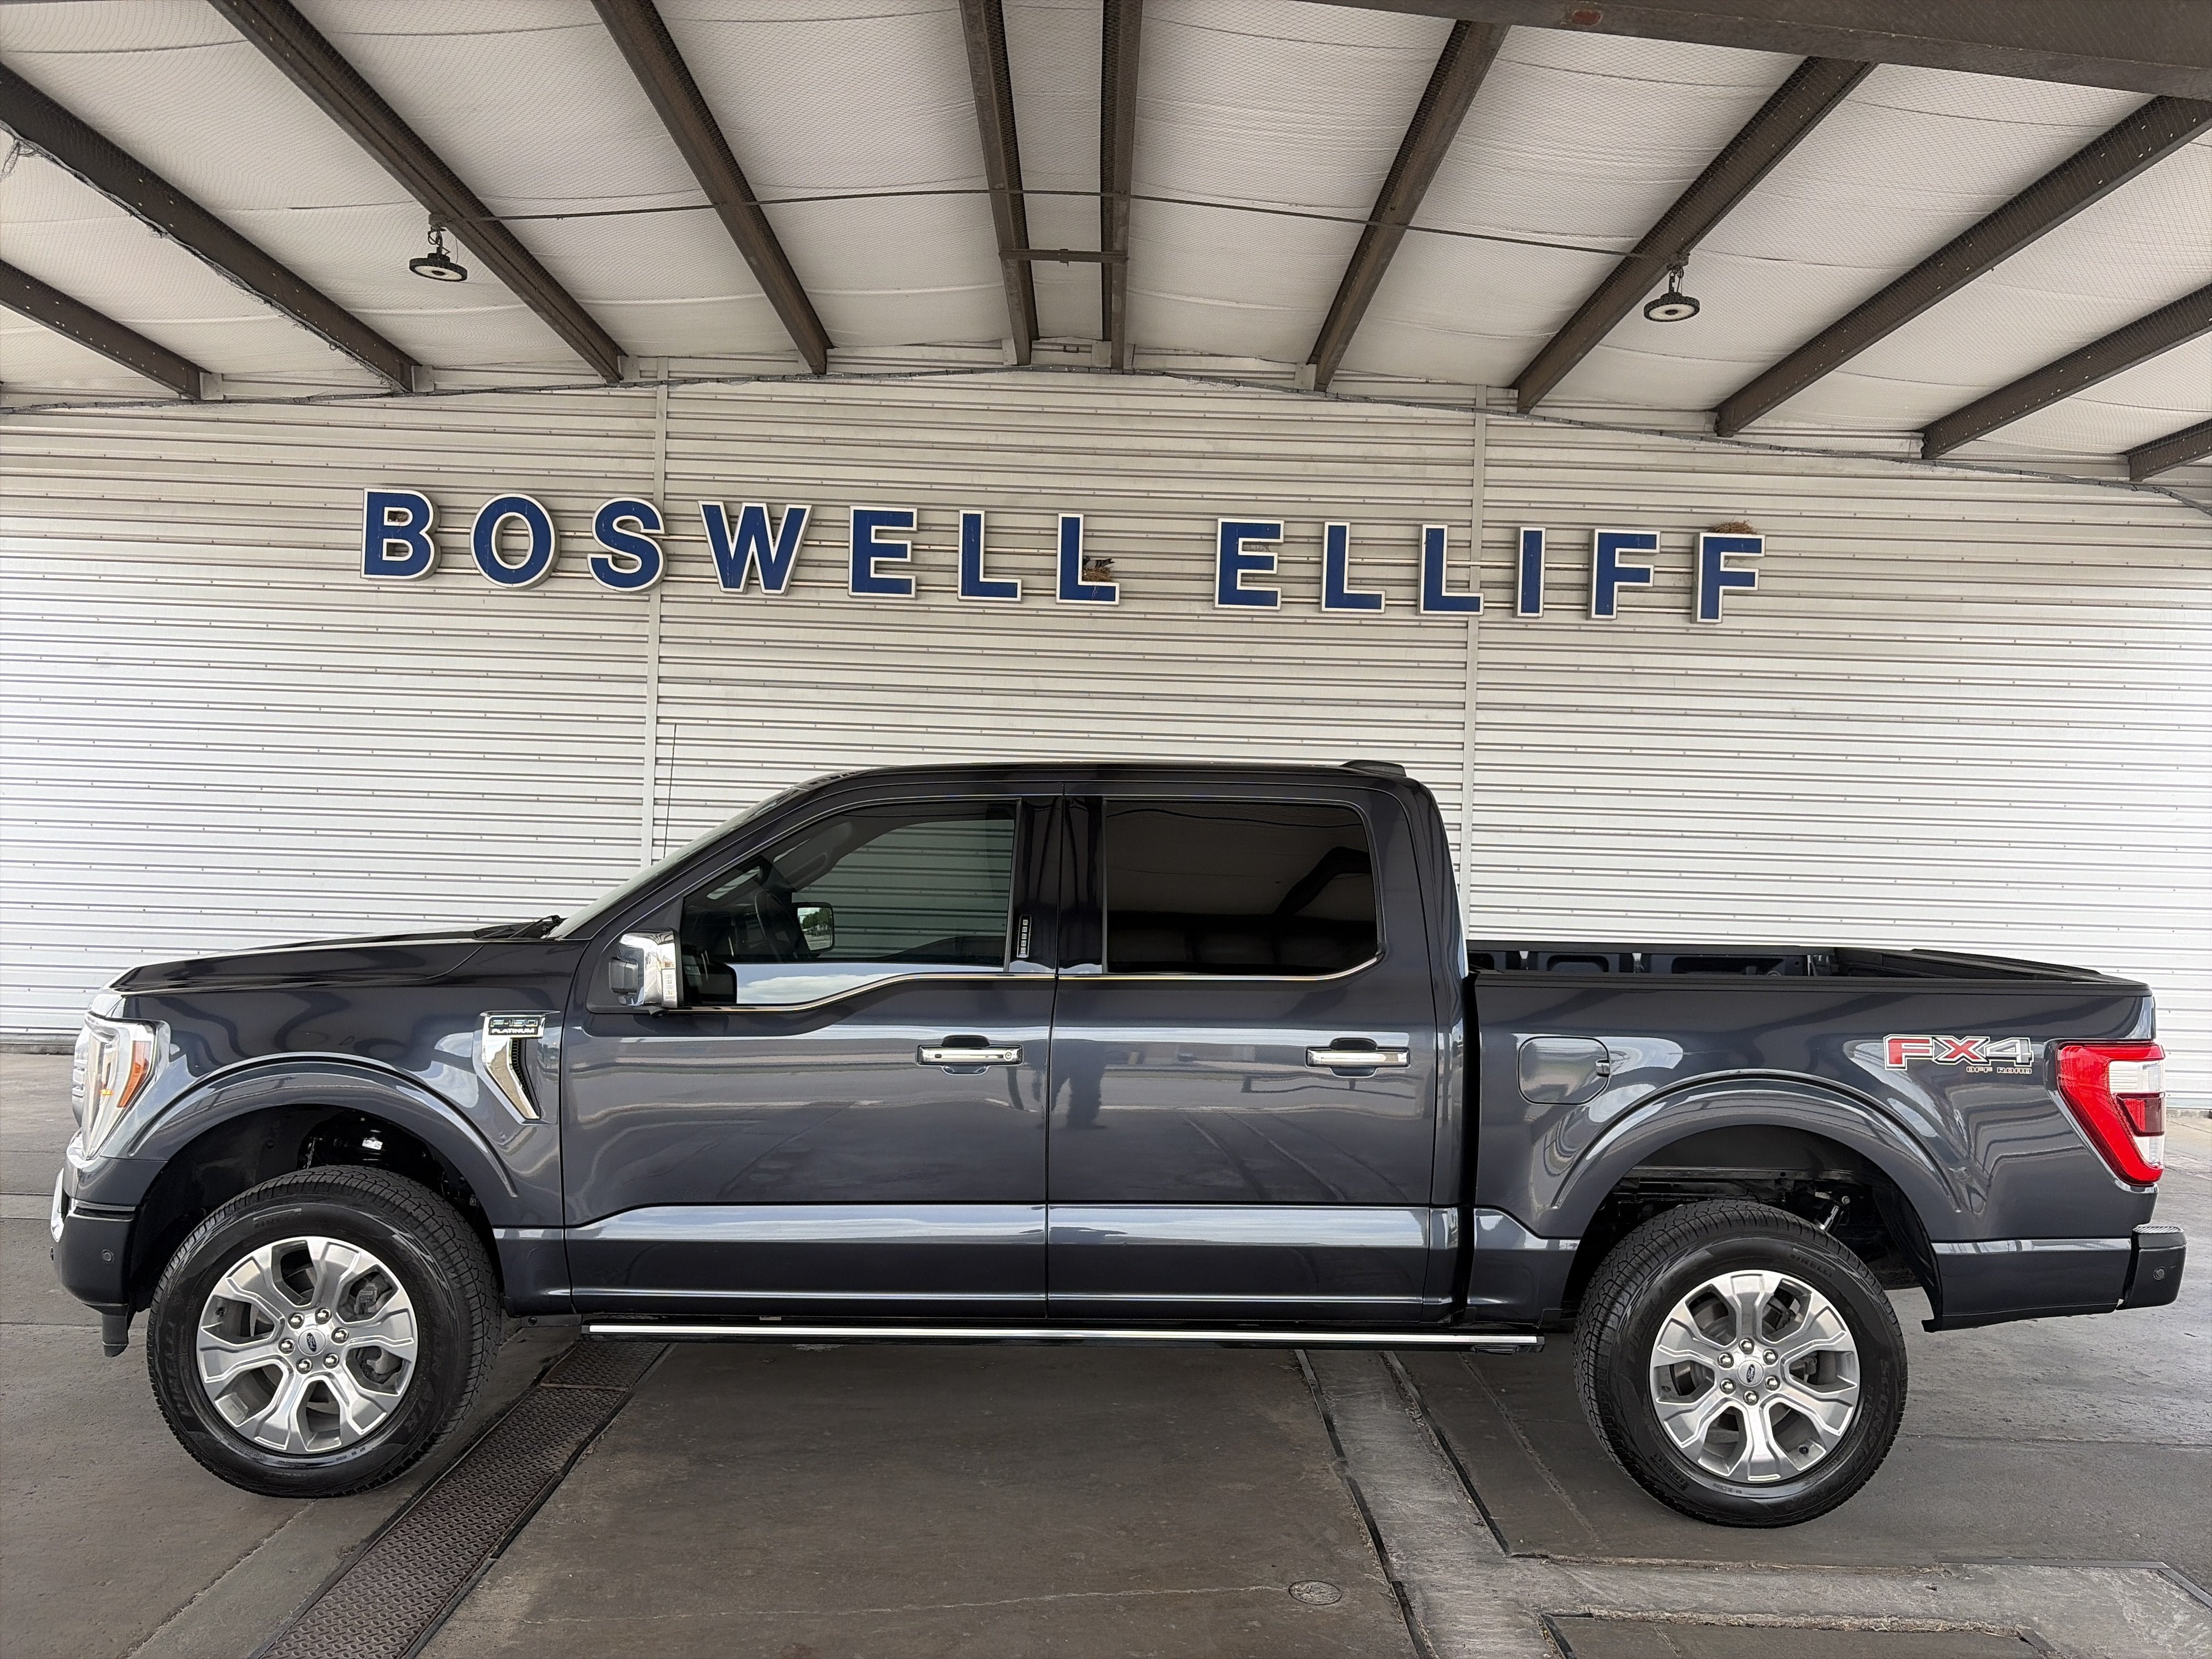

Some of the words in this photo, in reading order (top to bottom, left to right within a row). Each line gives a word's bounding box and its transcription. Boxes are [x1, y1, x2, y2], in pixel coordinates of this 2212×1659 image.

[361, 488, 1120, 605] BOSWELL
[1213, 517, 1765, 624] ELLIFF
[1883, 1034, 2034, 1071] FX4
[1996, 1066, 2032, 1074] ROAD
[307, 1333, 316, 1351] Ford
[1747, 1364, 1755, 1382] Ford
